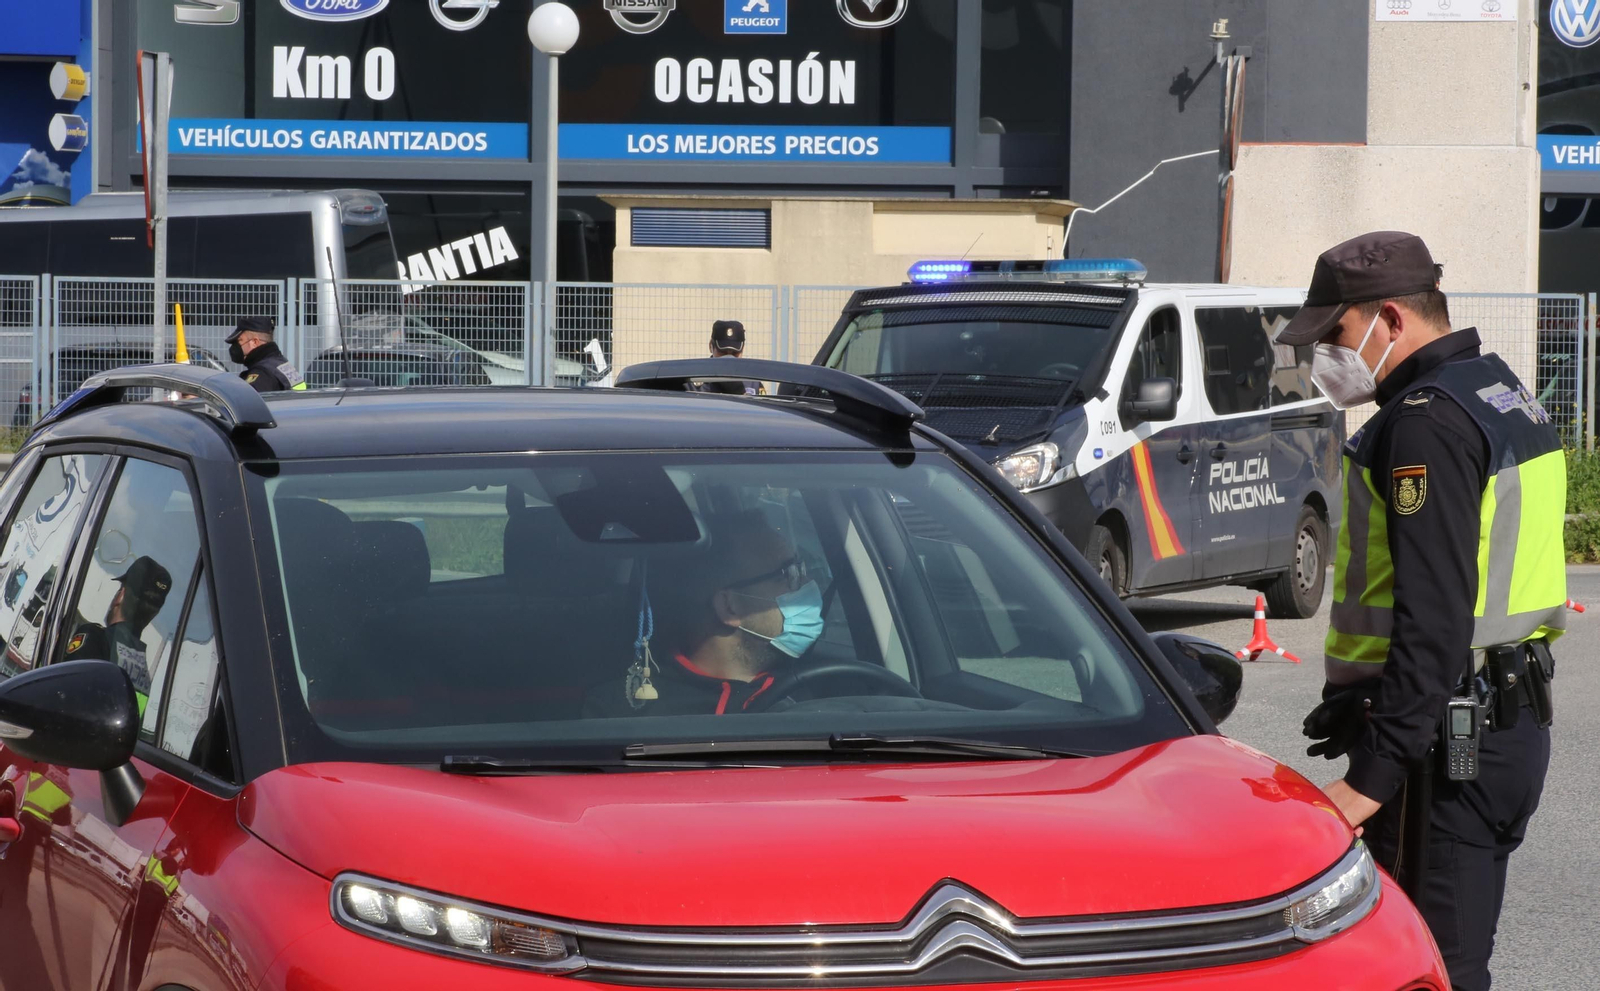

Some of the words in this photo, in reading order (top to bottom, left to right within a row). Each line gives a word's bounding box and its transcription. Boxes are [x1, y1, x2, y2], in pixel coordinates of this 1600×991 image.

[730, 17, 781, 27] PEUGEOT
[273, 46, 351, 99] Km
[364, 47, 395, 100] 0
[654, 52, 856, 105] OCASIÓN
[178, 125, 302, 148] VEHÍCULOS
[310, 130, 488, 151] GARANTIZADOS
[627, 134, 669, 154] LOS
[674, 135, 776, 155] MEJORES
[785, 136, 879, 156] PRECIOS
[1104, 421, 1117, 435] 091
[1209, 451, 1270, 486] POLICÍA
[1208, 482, 1286, 515] NACIONAL
